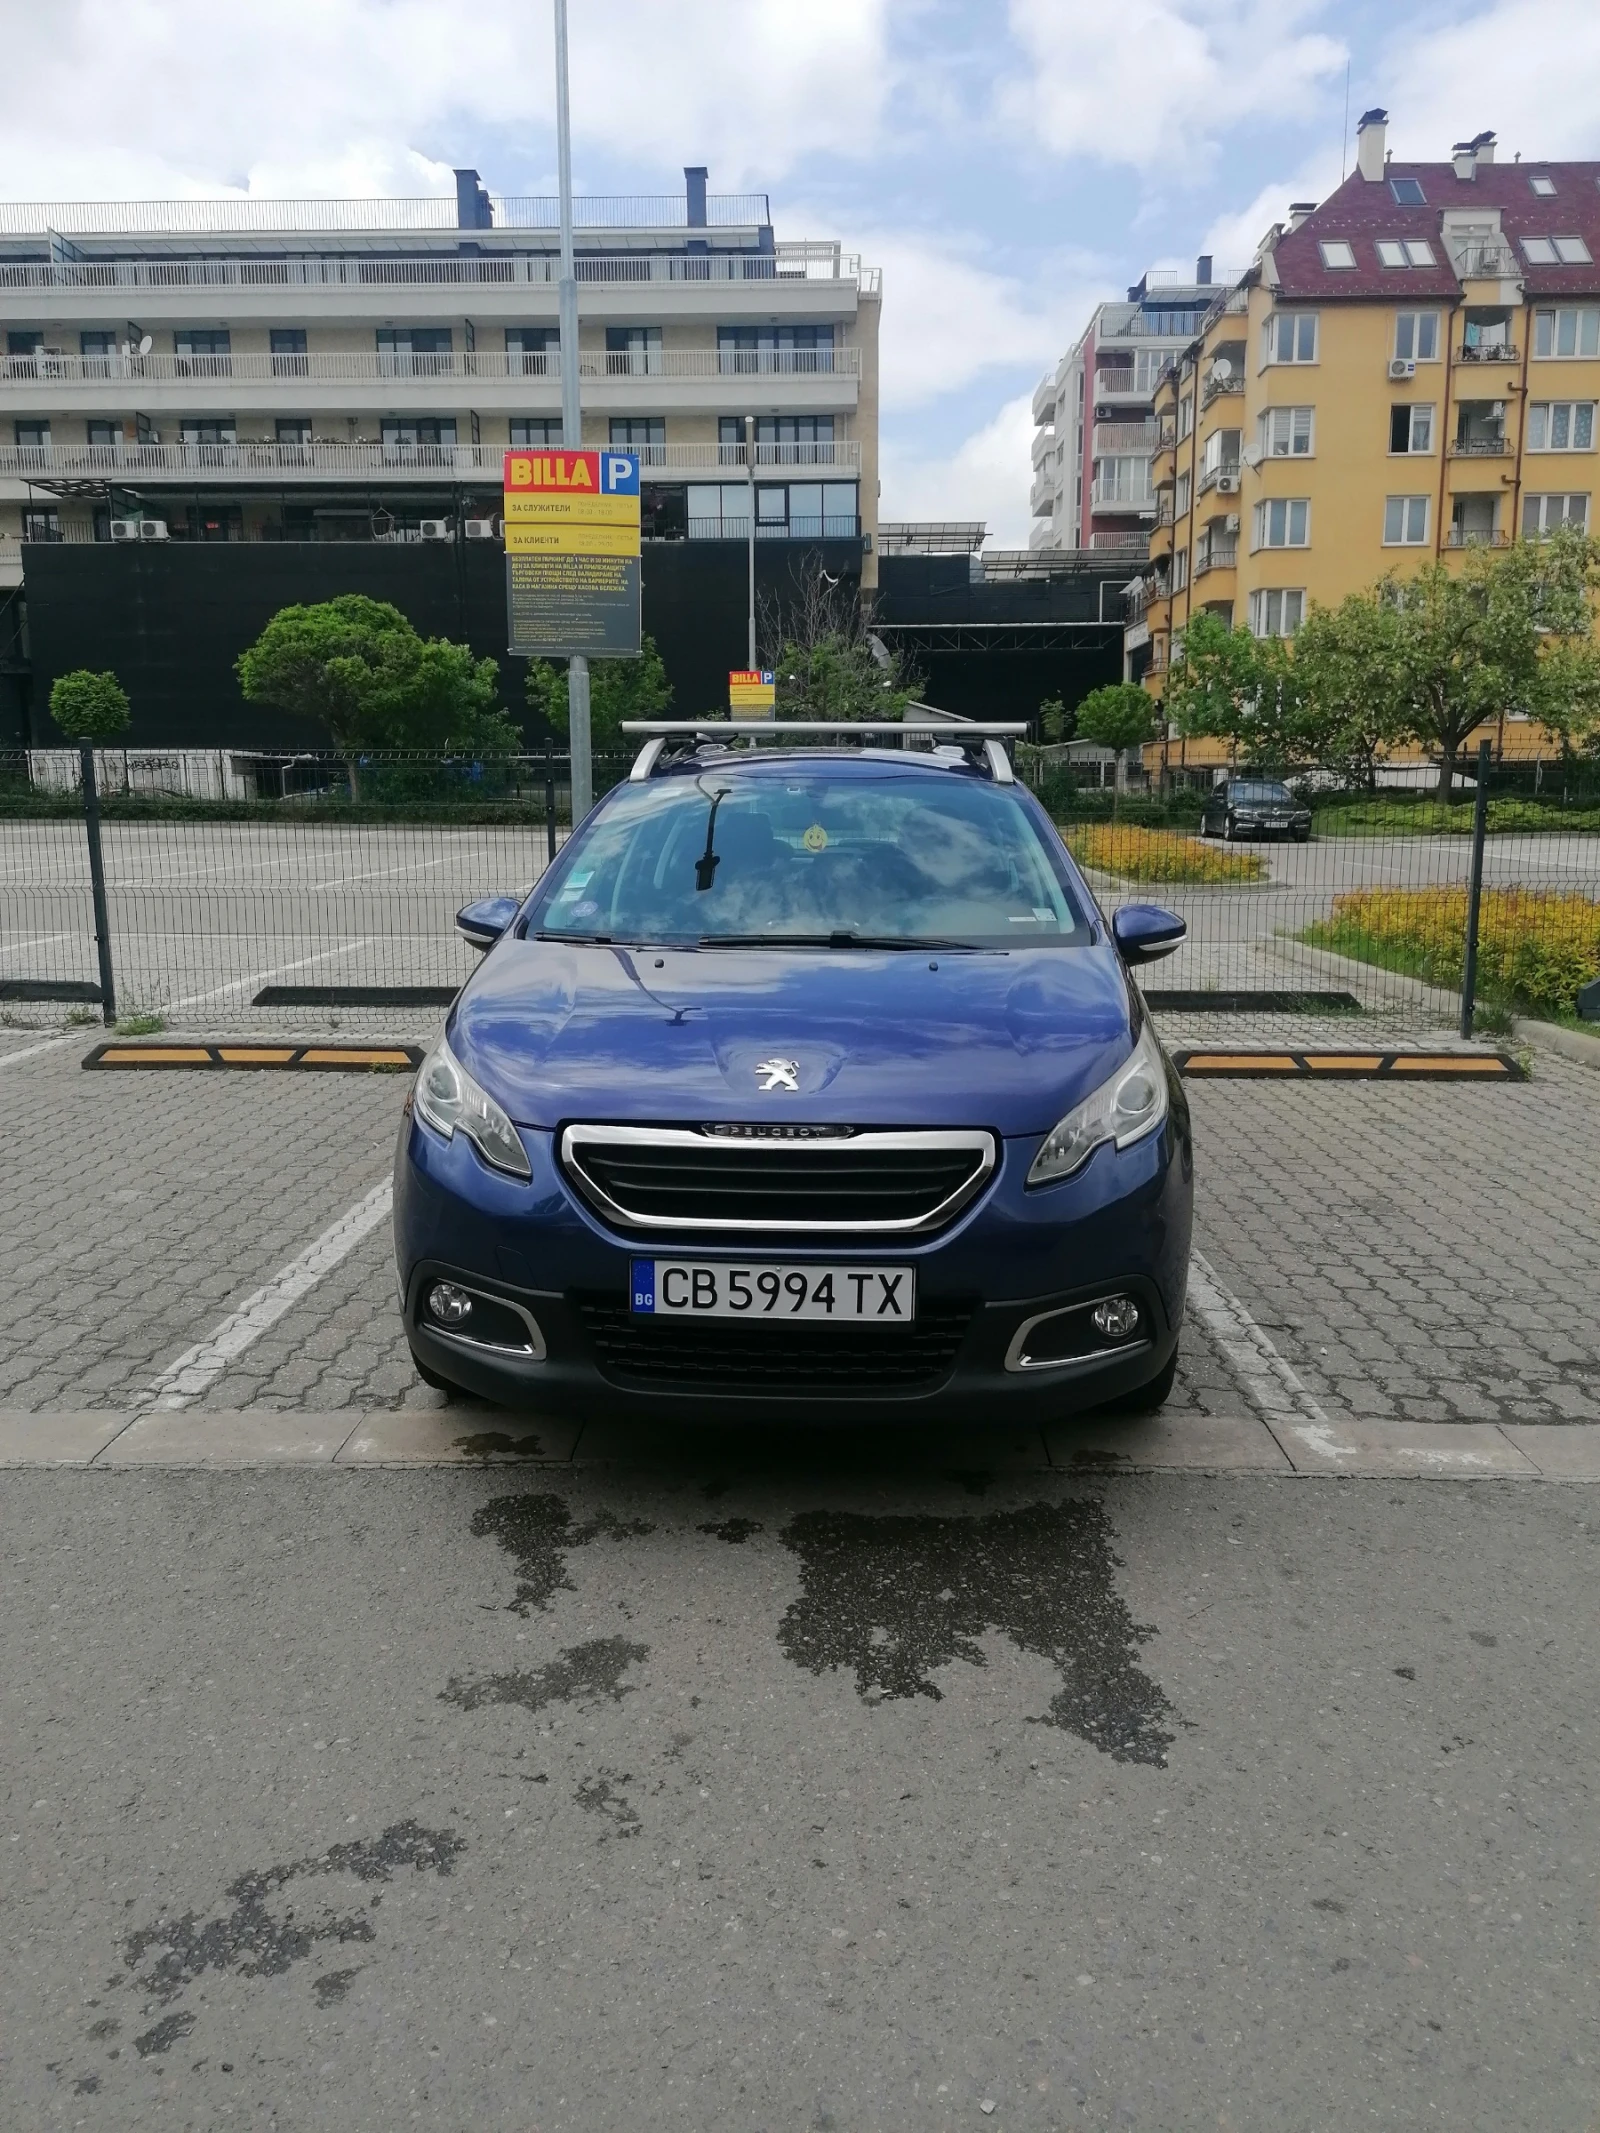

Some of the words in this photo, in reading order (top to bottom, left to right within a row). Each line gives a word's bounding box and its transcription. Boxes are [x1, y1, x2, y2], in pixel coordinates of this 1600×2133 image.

[510, 458, 592, 486] BILLA
[608, 458, 633, 490] P
[512, 504, 522, 512] ЗА
[524, 504, 571, 512] СЛУЖИТЕЛИ
[524, 536, 560, 544] КЛИЕНТИ
[732, 674, 759, 684] BILLA
[764, 672, 772, 684] P
[635, 1293, 653, 1306] BG
